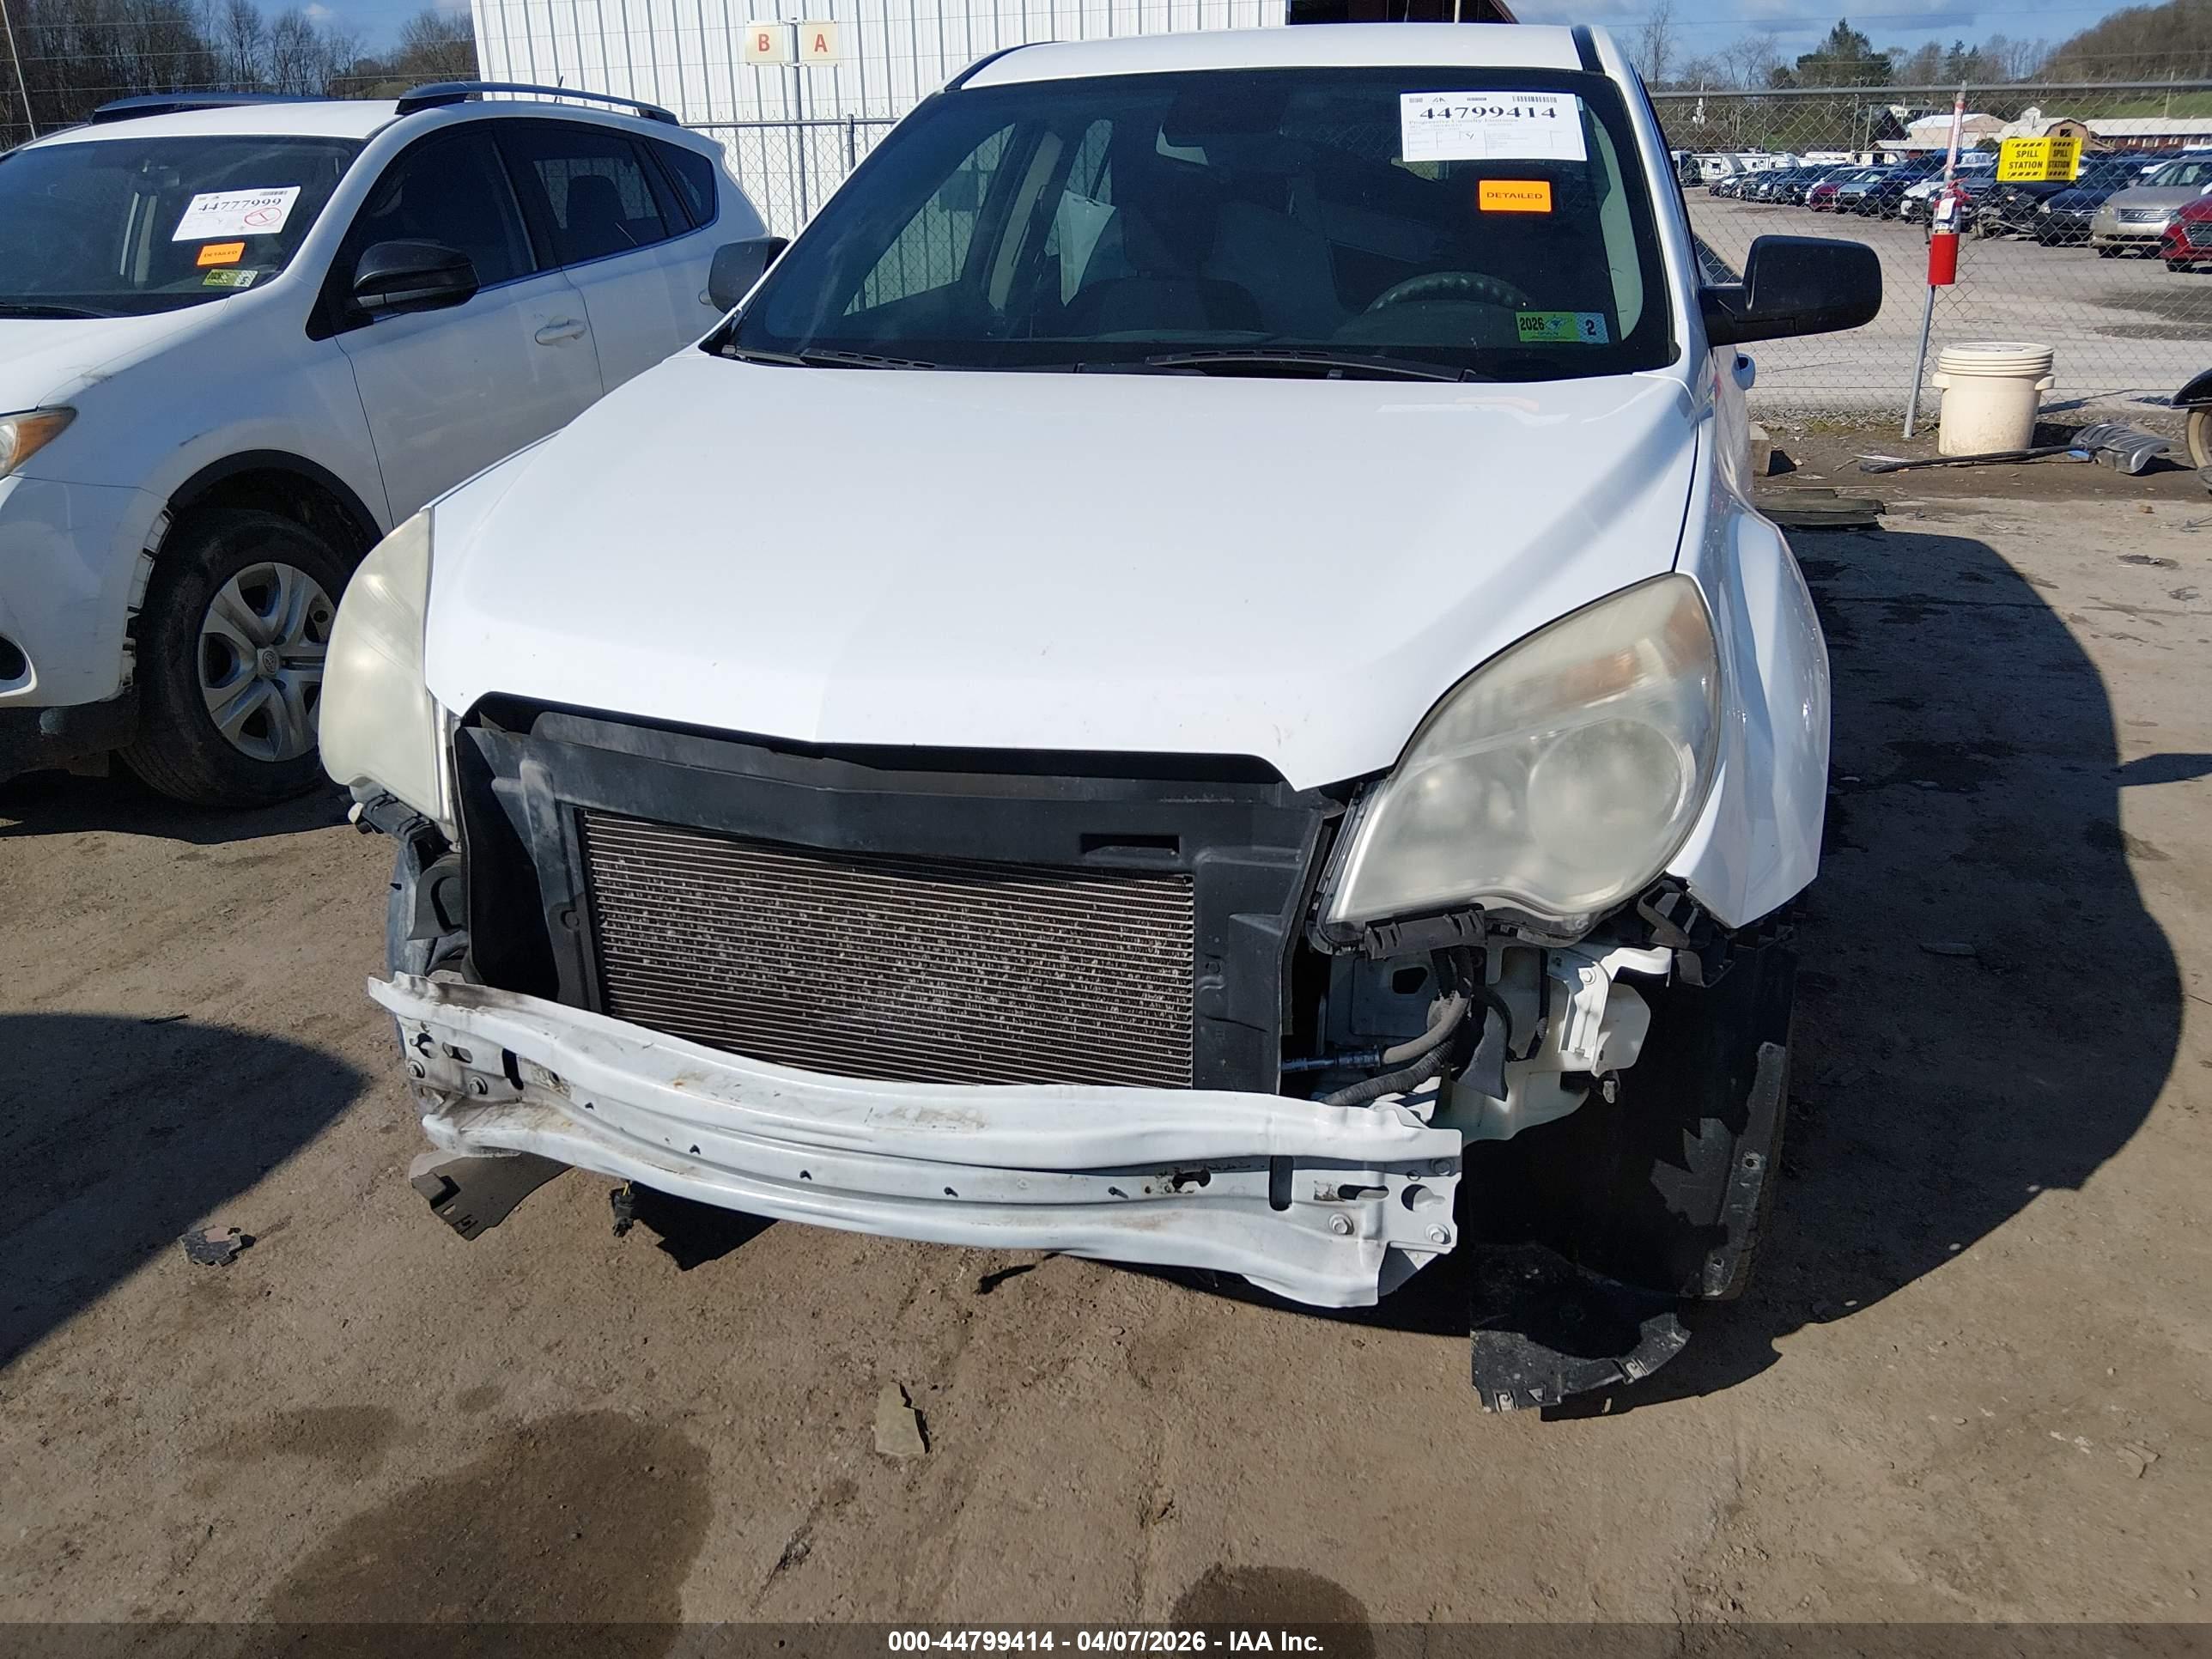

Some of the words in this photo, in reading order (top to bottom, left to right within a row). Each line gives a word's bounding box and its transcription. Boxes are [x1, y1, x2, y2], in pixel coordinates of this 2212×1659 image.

[758, 33, 770, 52] B
[814, 33, 828, 52] A
[1419, 106, 1558, 118] 44799414
[2015, 149, 2039, 158] SPILL
[2008, 161, 2044, 169] STATION
[1486, 191, 1543, 200] DETAILED
[199, 198, 281, 211] 44777999
[1519, 316, 1545, 331] 2026
[1585, 319, 1597, 336] 2
